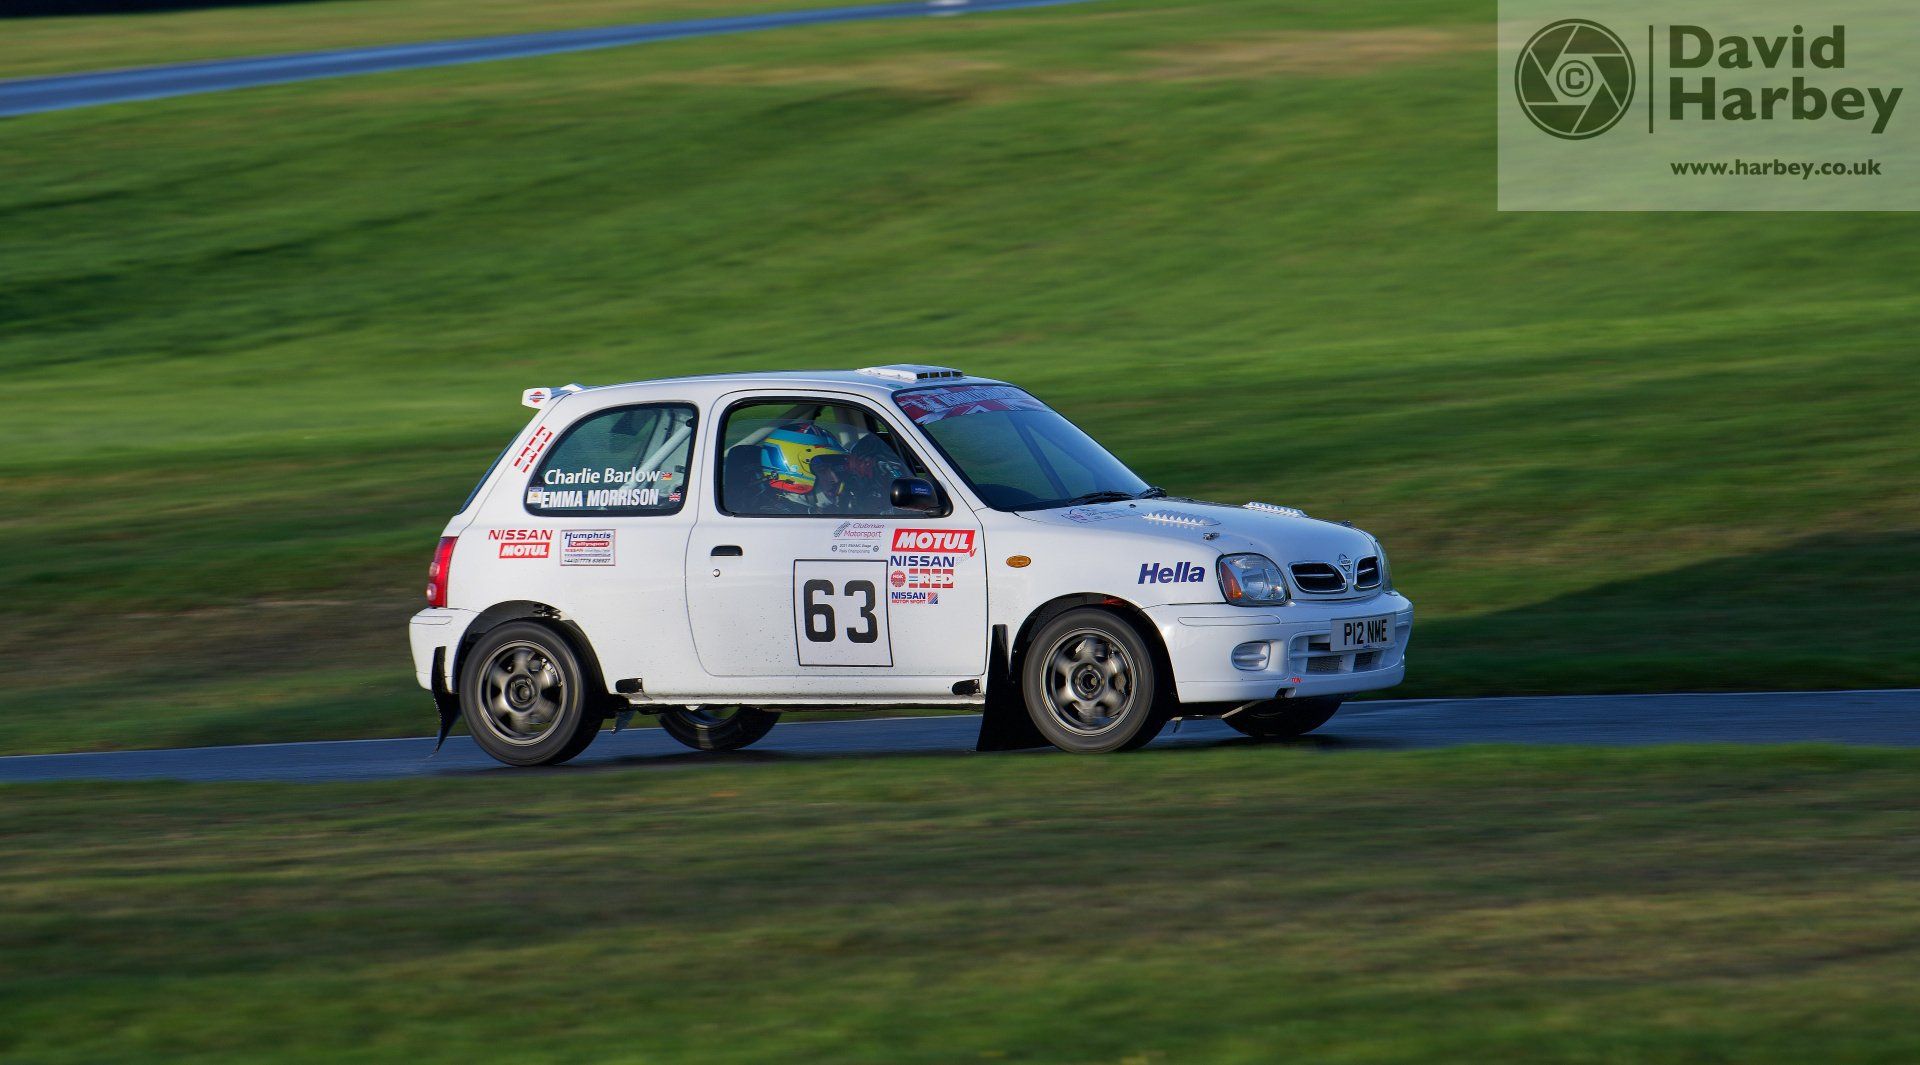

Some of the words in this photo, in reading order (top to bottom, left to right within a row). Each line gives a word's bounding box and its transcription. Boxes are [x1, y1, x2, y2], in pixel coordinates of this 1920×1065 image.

[544, 468, 600, 485] Charlie
[603, 467, 660, 483] Barlow
[541, 491, 583, 508] EMMA
[587, 489, 659, 506] MORRISON
[488, 529, 554, 540] NISSAN
[565, 532, 611, 544] Humphris
[843, 530, 882, 538] Motorsport
[895, 532, 969, 549] MOTUL
[501, 544, 548, 556] MOTUL
[890, 555, 954, 567] NISSAN
[1138, 562, 1206, 584] Hella
[891, 592, 926, 600] NISSAN
[804, 579, 878, 643] 63
[1367, 619, 1387, 643] NME
